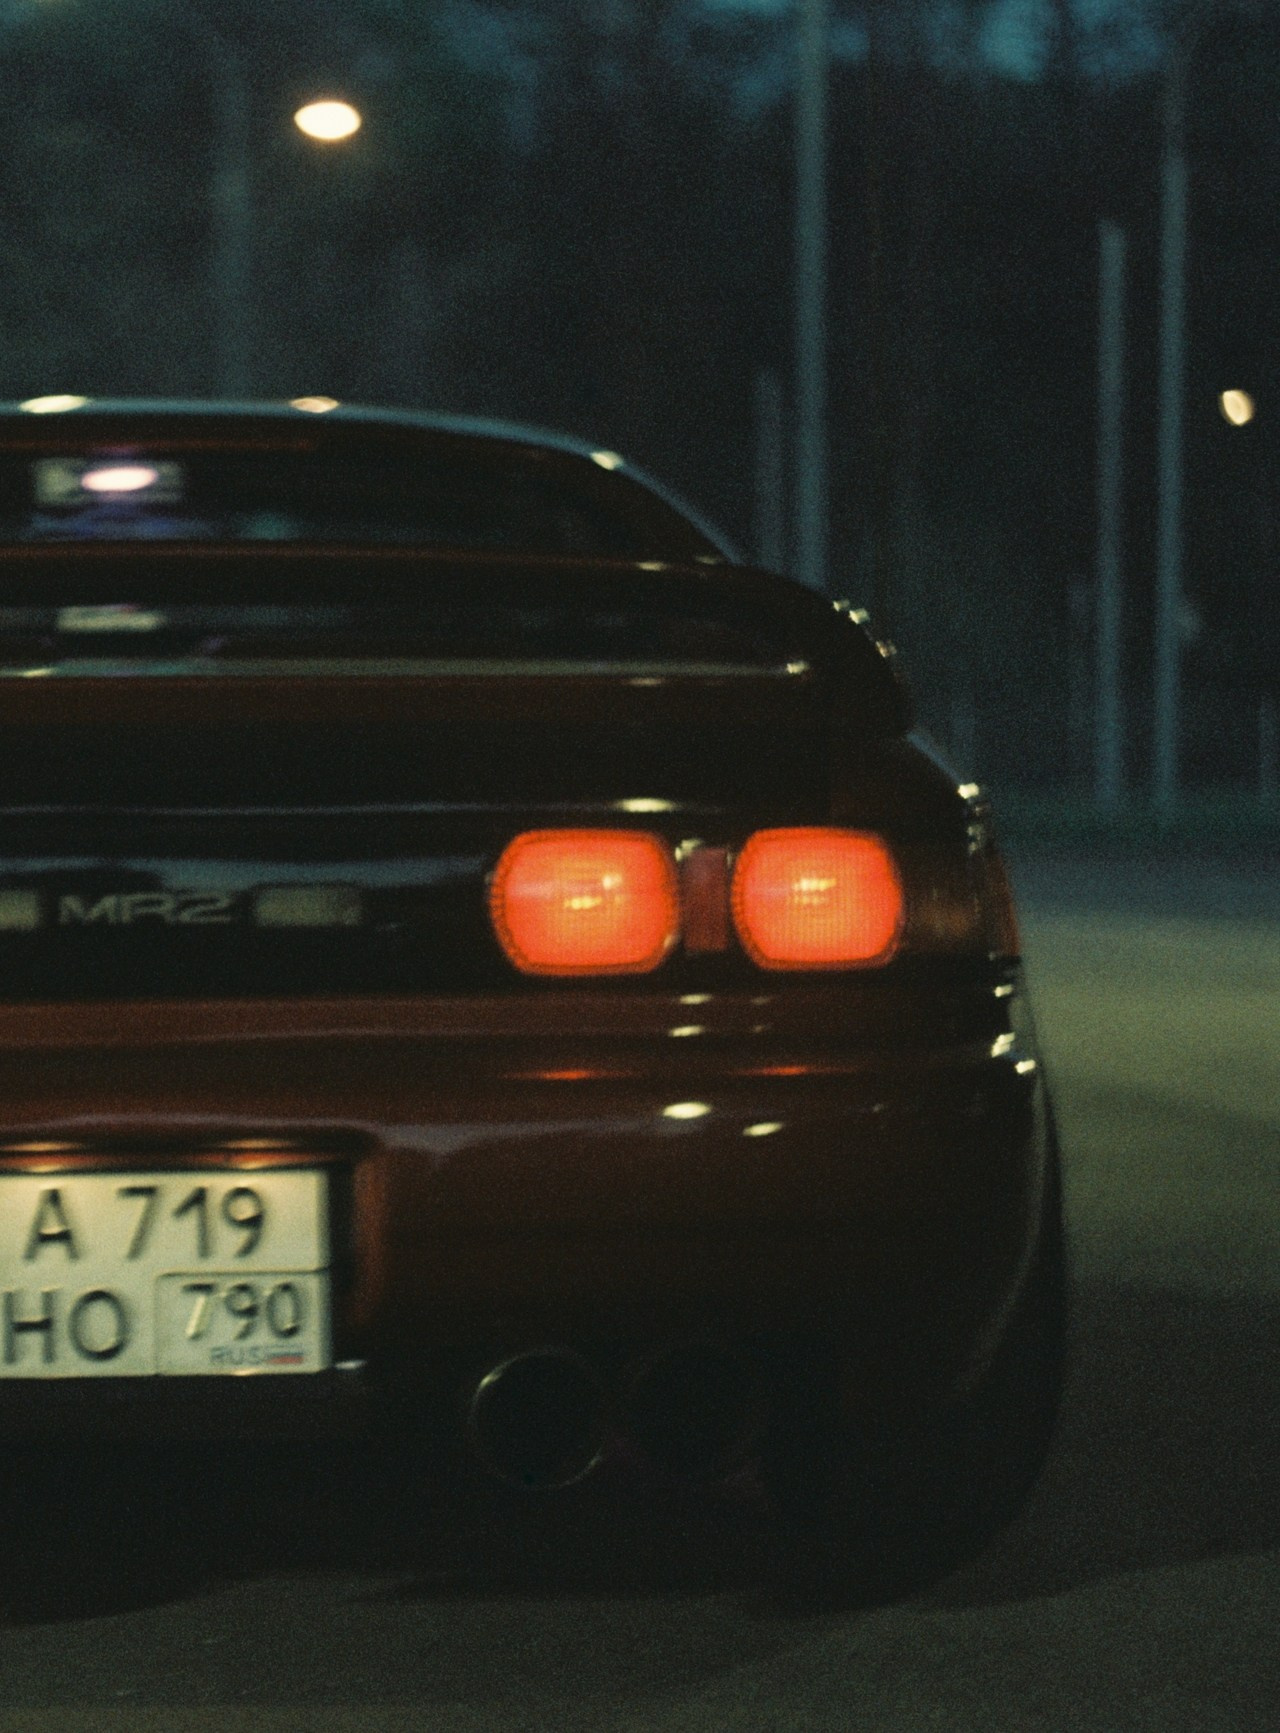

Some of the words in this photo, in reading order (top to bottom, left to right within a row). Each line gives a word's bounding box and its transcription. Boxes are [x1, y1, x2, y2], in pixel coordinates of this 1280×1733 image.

[58, 893, 234, 925] MR2
[117, 1186, 266, 1260] 719
[182, 1283, 303, 1341] 790
[211, 1347, 263, 1365] RUS
